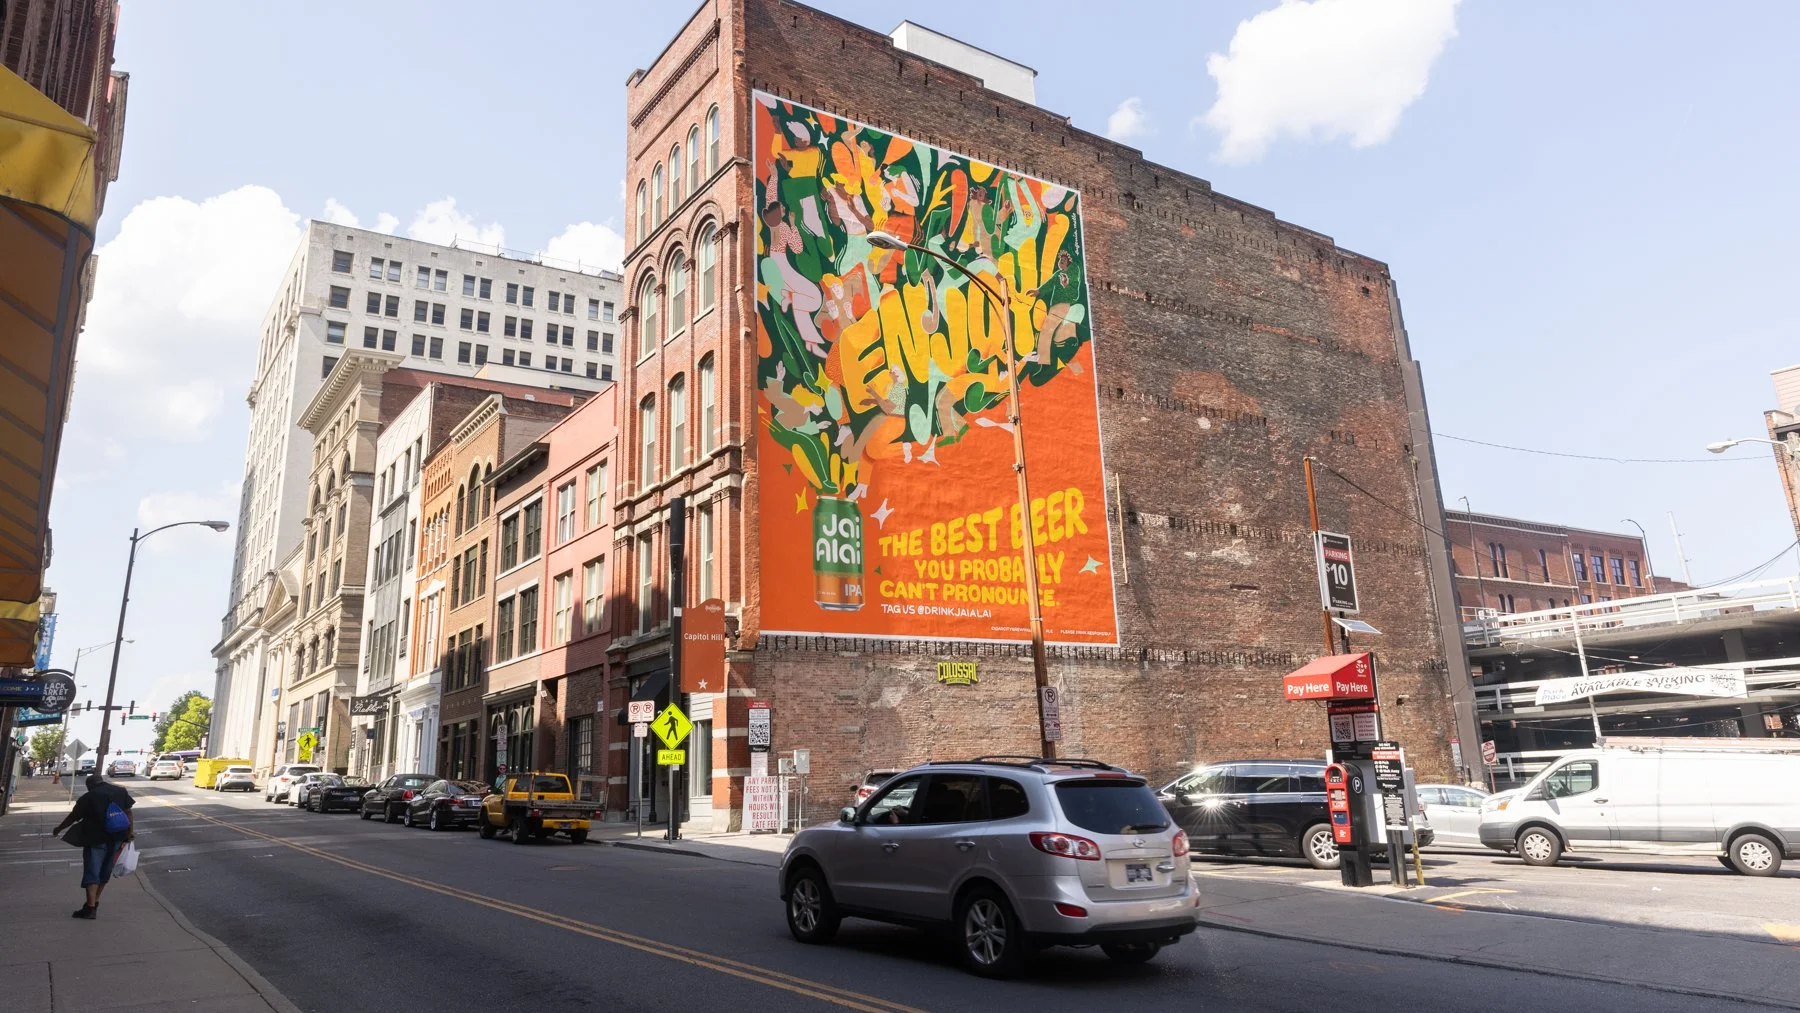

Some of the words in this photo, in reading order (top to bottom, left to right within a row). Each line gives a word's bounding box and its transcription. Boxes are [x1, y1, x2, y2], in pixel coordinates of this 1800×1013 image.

[822, 513, 860, 538] Jai
[878, 529, 923, 557] THE
[930, 506, 1004, 556] BEST
[1010, 487, 1089, 550] BEER
[816, 538, 861, 565] Alai
[1325, 549, 1348, 560] PARKING
[914, 559, 955, 580] YOU
[959, 551, 1065, 584] PROBALY
[1325, 562, 1348, 586] $10
[844, 584, 862, 596] IPA
[879, 580, 939, 600] CAN'T
[881, 604, 901, 613] TAG
[902, 604, 916, 614] US
[917, 606, 992, 618] @DRINKJAIALAI
[684, 632, 709, 641] Capitol
[937, 661, 978, 681] COLOSSAL
[1647, 674, 1706, 687] ARKING
[1287, 684, 1305, 696] Pay
[1305, 682, 1330, 693] Here
[1336, 681, 1350, 694] Pay
[1350, 682, 1369, 692] Here
[748, 777, 759, 785] ANY
[746, 785, 760, 793] FEES
[761, 785, 773, 793] NOT
[749, 803, 768, 811] HOURS
[752, 811, 773, 819] RESULT
[752, 820, 765, 828] LATE
[767, 820, 780, 828] FEE
